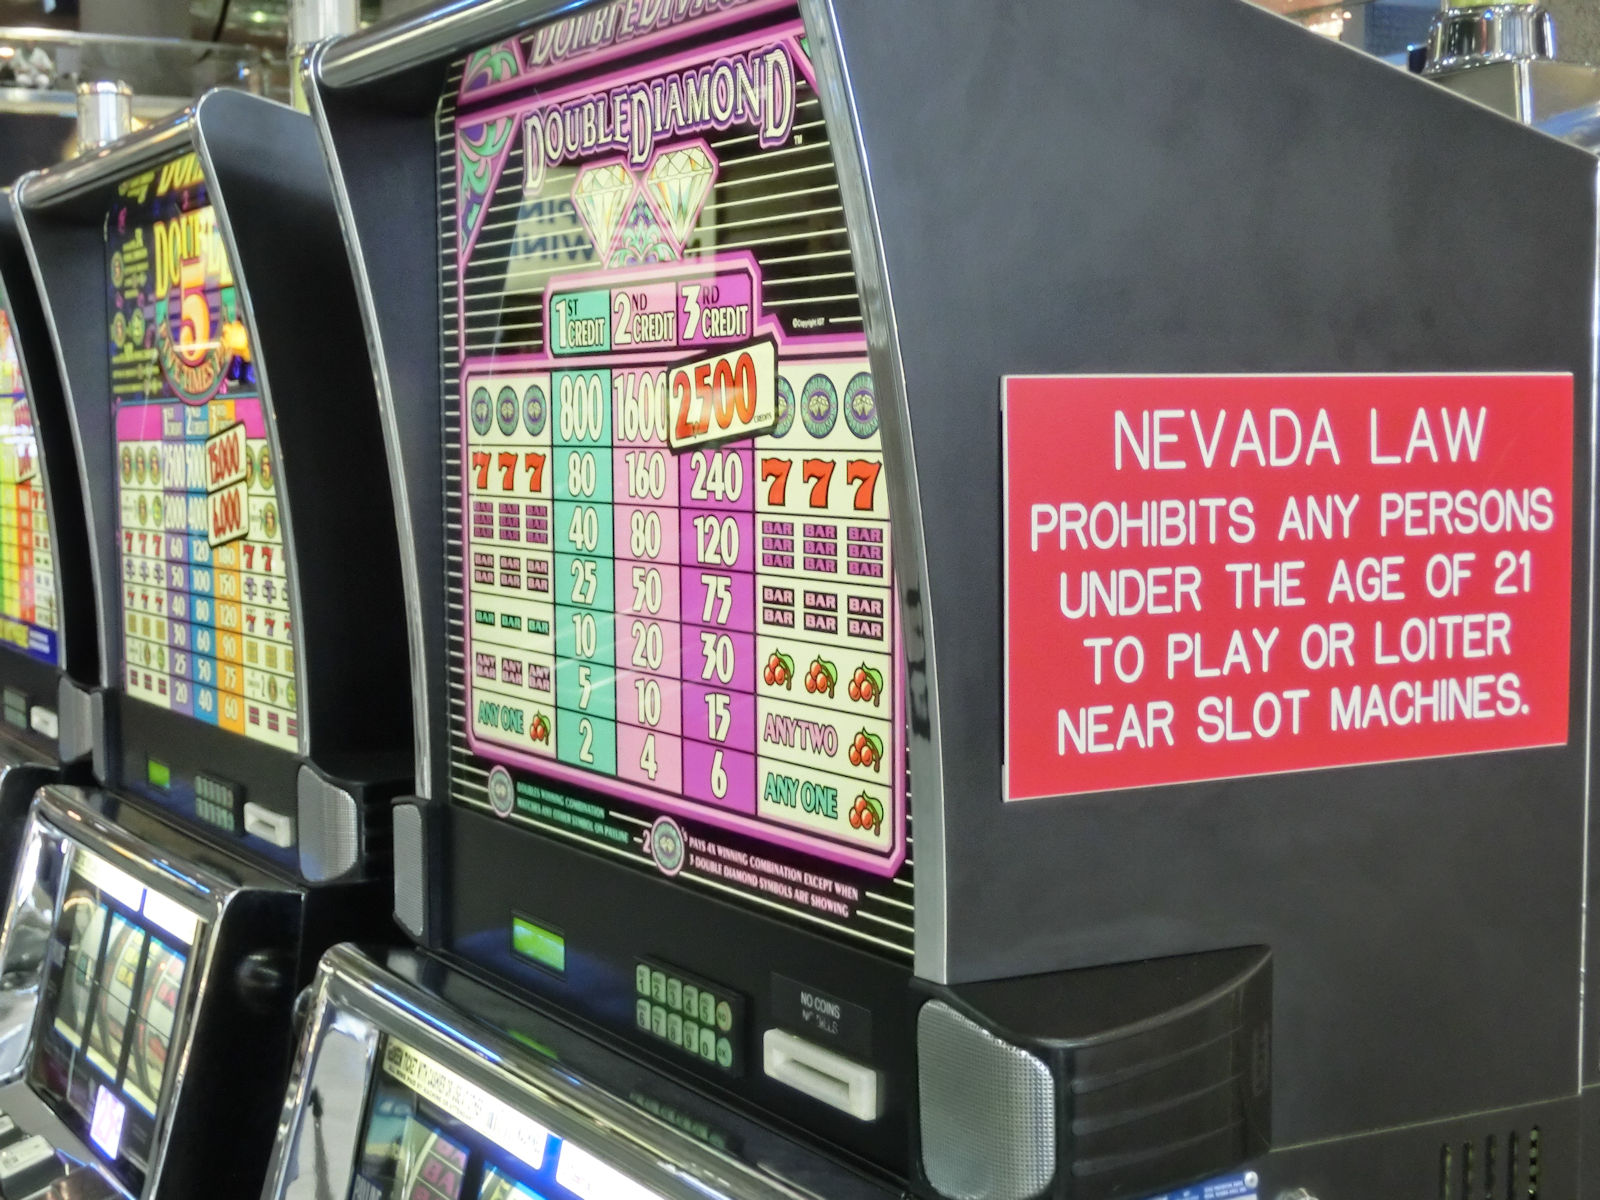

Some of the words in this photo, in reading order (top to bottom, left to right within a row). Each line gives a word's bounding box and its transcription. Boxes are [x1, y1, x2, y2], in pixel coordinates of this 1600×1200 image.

[568, 317, 605, 347] CREDIT
[633, 311, 675, 343] CREDIT
[702, 305, 748, 338] CREDIT
[560, 373, 604, 442] 800
[614, 371, 668, 442] 1600
[1114, 408, 1340, 470] NEVADA
[1370, 407, 1487, 465] LAW
[568, 450, 596, 497] 80
[625, 450, 666, 499] 160
[690, 451, 743, 502] 240
[761, 457, 793, 506] 7
[803, 458, 836, 509] 7
[847, 459, 883, 511] 7
[569, 505, 599, 552] 40
[631, 509, 661, 558] 80
[693, 515, 740, 568] 120
[763, 521, 793, 535] BAR
[804, 524, 836, 539] BAR
[848, 526, 881, 543] BAR
[1031, 498, 1255, 551] PROHIBITS
[1278, 494, 1359, 541] ANY
[1380, 488, 1555, 537] PERSONS
[763, 537, 793, 551] BAR
[804, 540, 836, 556] BAR
[848, 544, 881, 560] BAR
[763, 553, 793, 568] BAR
[804, 557, 836, 573] BAR
[848, 561, 881, 577] BAR
[571, 558, 597, 605] 25
[632, 567, 663, 614] 50
[701, 573, 732, 625] 75
[764, 587, 793, 605] BAR
[805, 592, 836, 610] BAR
[849, 597, 882, 615] BAR
[1060, 565, 1202, 619] UNDER
[1225, 561, 1305, 608] THE
[1328, 555, 1405, 604] AGE
[1425, 553, 1476, 599] OF
[1494, 550, 1531, 594] 21
[528, 619, 549, 635] BAR
[572, 613, 596, 658] 10
[632, 619, 664, 670] 20
[764, 608, 793, 626] BAR
[805, 614, 837, 632] BAR
[849, 619, 882, 638] BAR
[701, 631, 735, 684] 30
[1083, 636, 1144, 684] TO
[1168, 627, 1279, 680] PLAY
[1300, 622, 1354, 669] OR
[1375, 613, 1511, 665] LOITER
[579, 665, 591, 710] 5
[635, 678, 661, 726] 10
[478, 700, 500, 728] ANY
[501, 705, 524, 735] ONE
[704, 692, 731, 742] 15
[764, 712, 798, 750] ANY
[797, 720, 838, 758] TWO
[1058, 701, 1175, 756] NEAR
[1197, 690, 1310, 743] SLOT
[1330, 673, 1530, 731] MACHINES.
[579, 717, 594, 764] 2
[640, 733, 658, 781] 4
[711, 749, 728, 800] 6
[764, 772, 799, 808] ANY
[800, 781, 838, 819] ONE
[695, 856, 722, 875] DOUBLE
[723, 864, 758, 888] DIAMOND
[759, 876, 792, 899] SYMBOLS
[793, 888, 809, 905] ARE
[810, 893, 849, 918] SHOWING
[717, 844, 748, 866] WINNING
[749, 855, 803, 882] COMBINATION
[803, 872, 834, 893] EXCEPT
[834, 882, 859, 901] WHEN
[801, 991, 813, 1008] NO
[814, 997, 841, 1019] COINS
